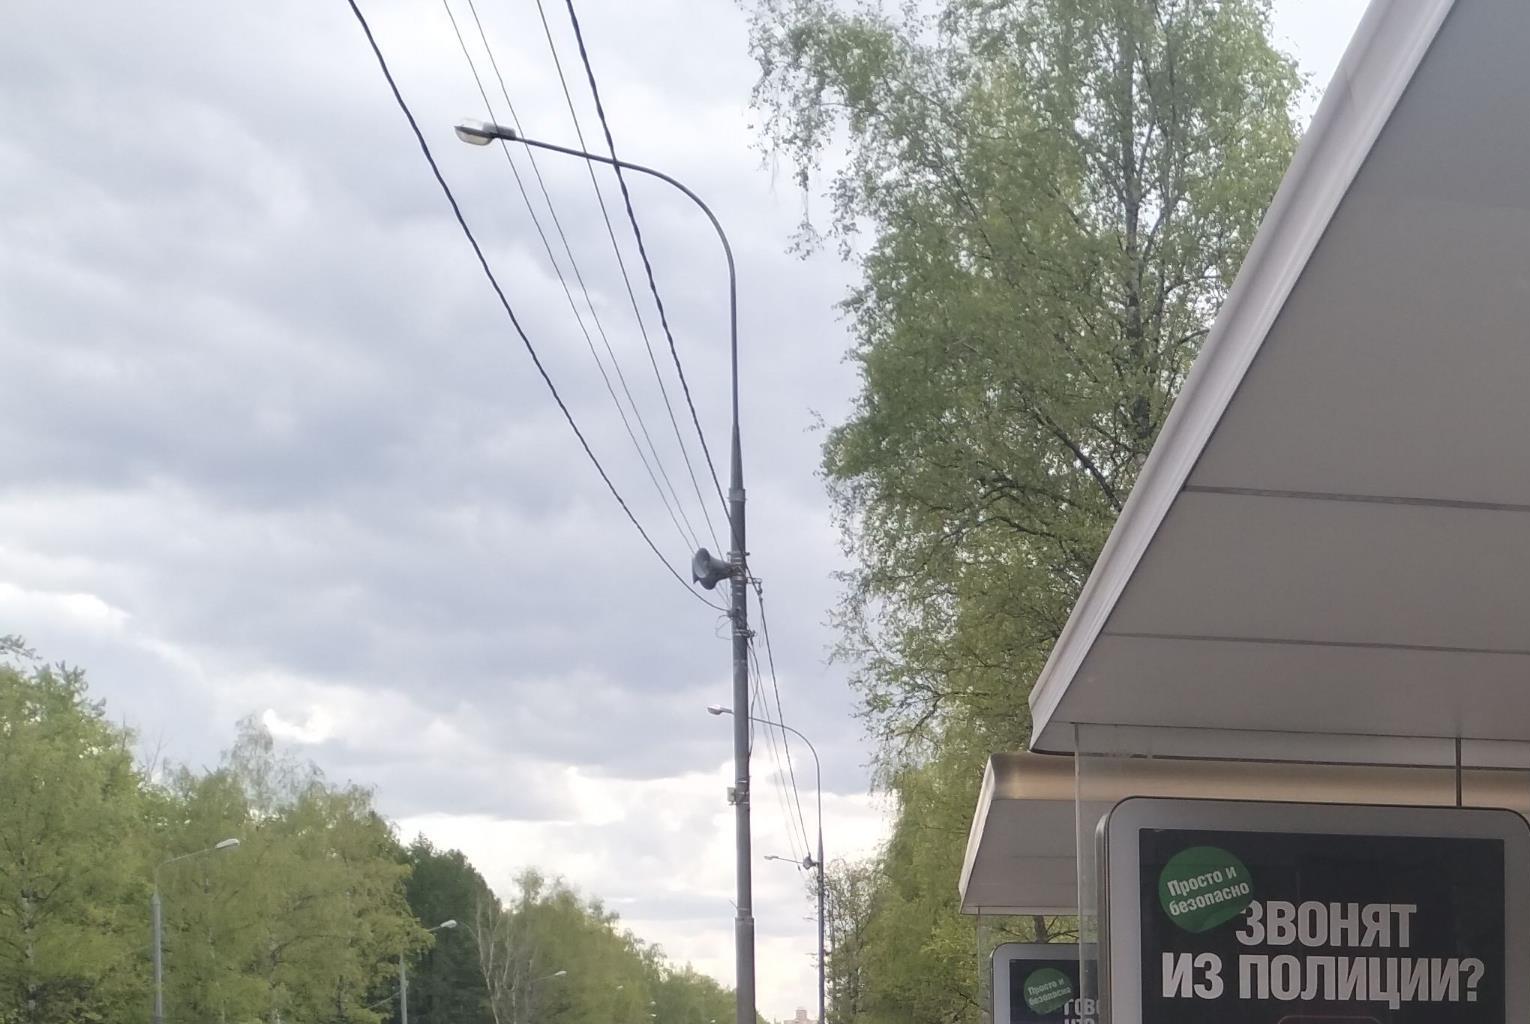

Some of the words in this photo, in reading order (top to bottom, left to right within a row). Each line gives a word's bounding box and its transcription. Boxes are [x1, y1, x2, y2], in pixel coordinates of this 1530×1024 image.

[1167, 871, 1223, 896] Просто
[1225, 866, 1237, 879] и
[1169, 882, 1250, 916] безопасно
[1235, 899, 1417, 948] ЗВОНЯТ
[1162, 951, 1224, 1000] ИЗ
[1238, 954, 1485, 1010] ПОЛИЦИИ?
